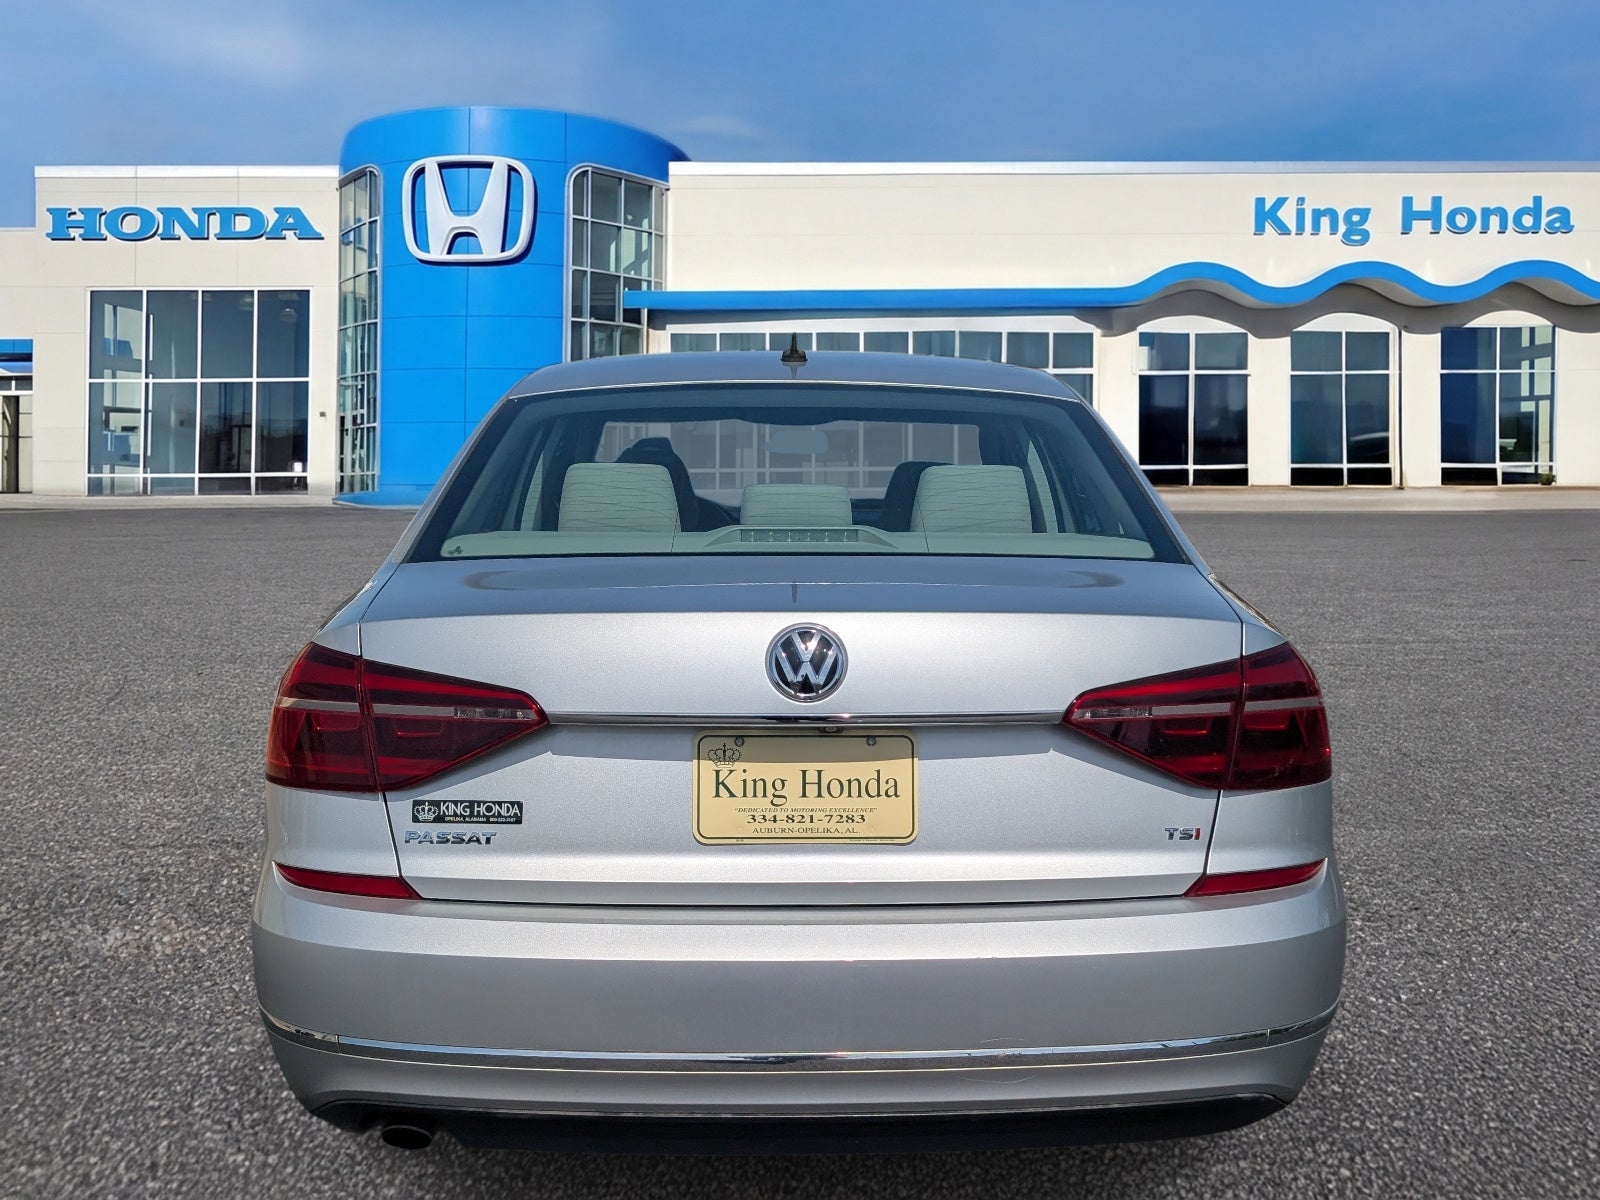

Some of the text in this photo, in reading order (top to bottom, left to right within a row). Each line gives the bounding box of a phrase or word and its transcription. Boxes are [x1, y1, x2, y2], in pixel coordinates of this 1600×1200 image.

[46, 207, 324, 241] HONDA
[1253, 195, 1575, 246] King Honda
[712, 769, 901, 807] King Honda
[440, 802, 521, 817] KING HONDA
[747, 814, 866, 824] 334-821-7283
[404, 831, 497, 844] PASSAT
[1164, 827, 1201, 841] TSI
